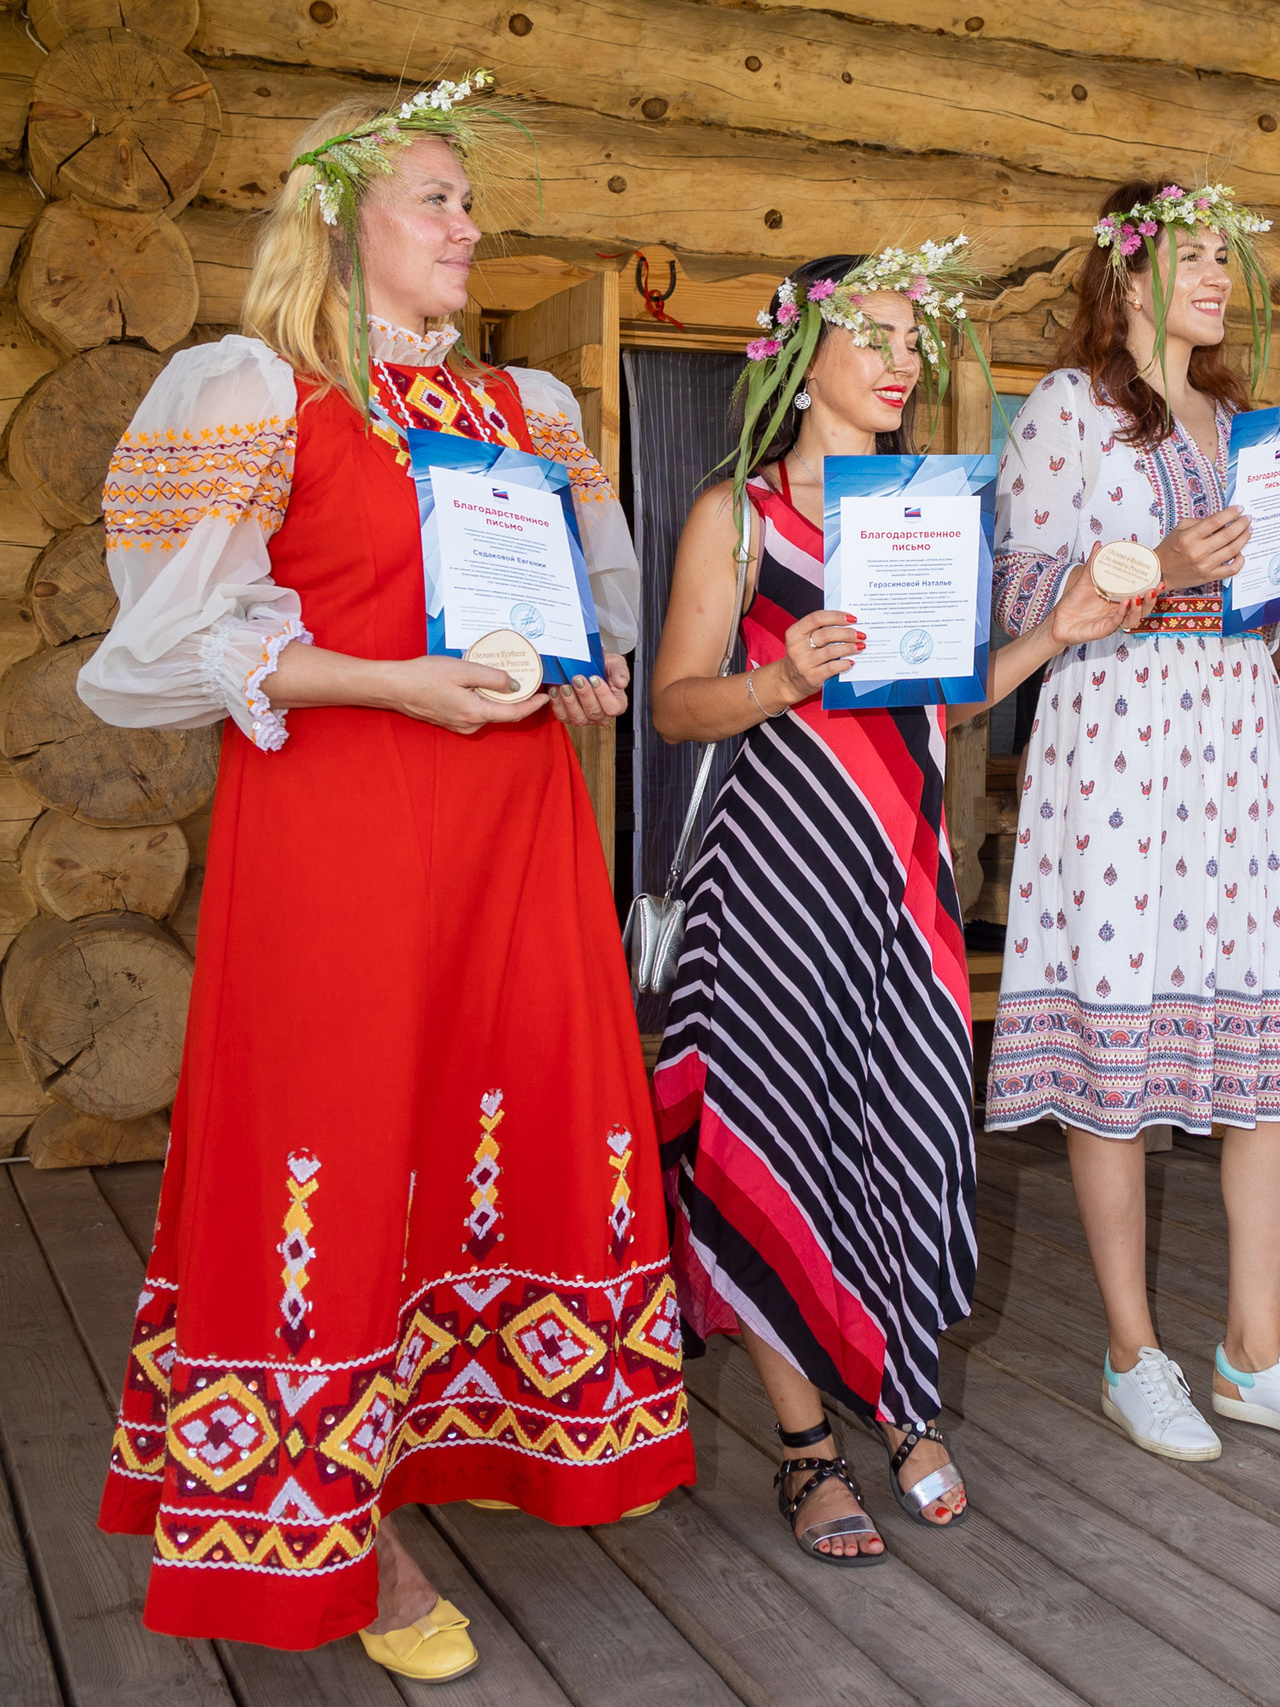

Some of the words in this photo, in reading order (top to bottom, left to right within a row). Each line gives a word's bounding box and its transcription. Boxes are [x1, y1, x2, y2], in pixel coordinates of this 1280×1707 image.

[453, 499, 550, 528] Благодарственное
[486, 518, 524, 532] письмо
[860, 529, 961, 540] Благодарственное
[892, 542, 931, 551] письмо
[473, 549, 516, 562] Седаковой
[516, 557, 547, 568] Евгении
[869, 580, 920, 588] Герасимовой
